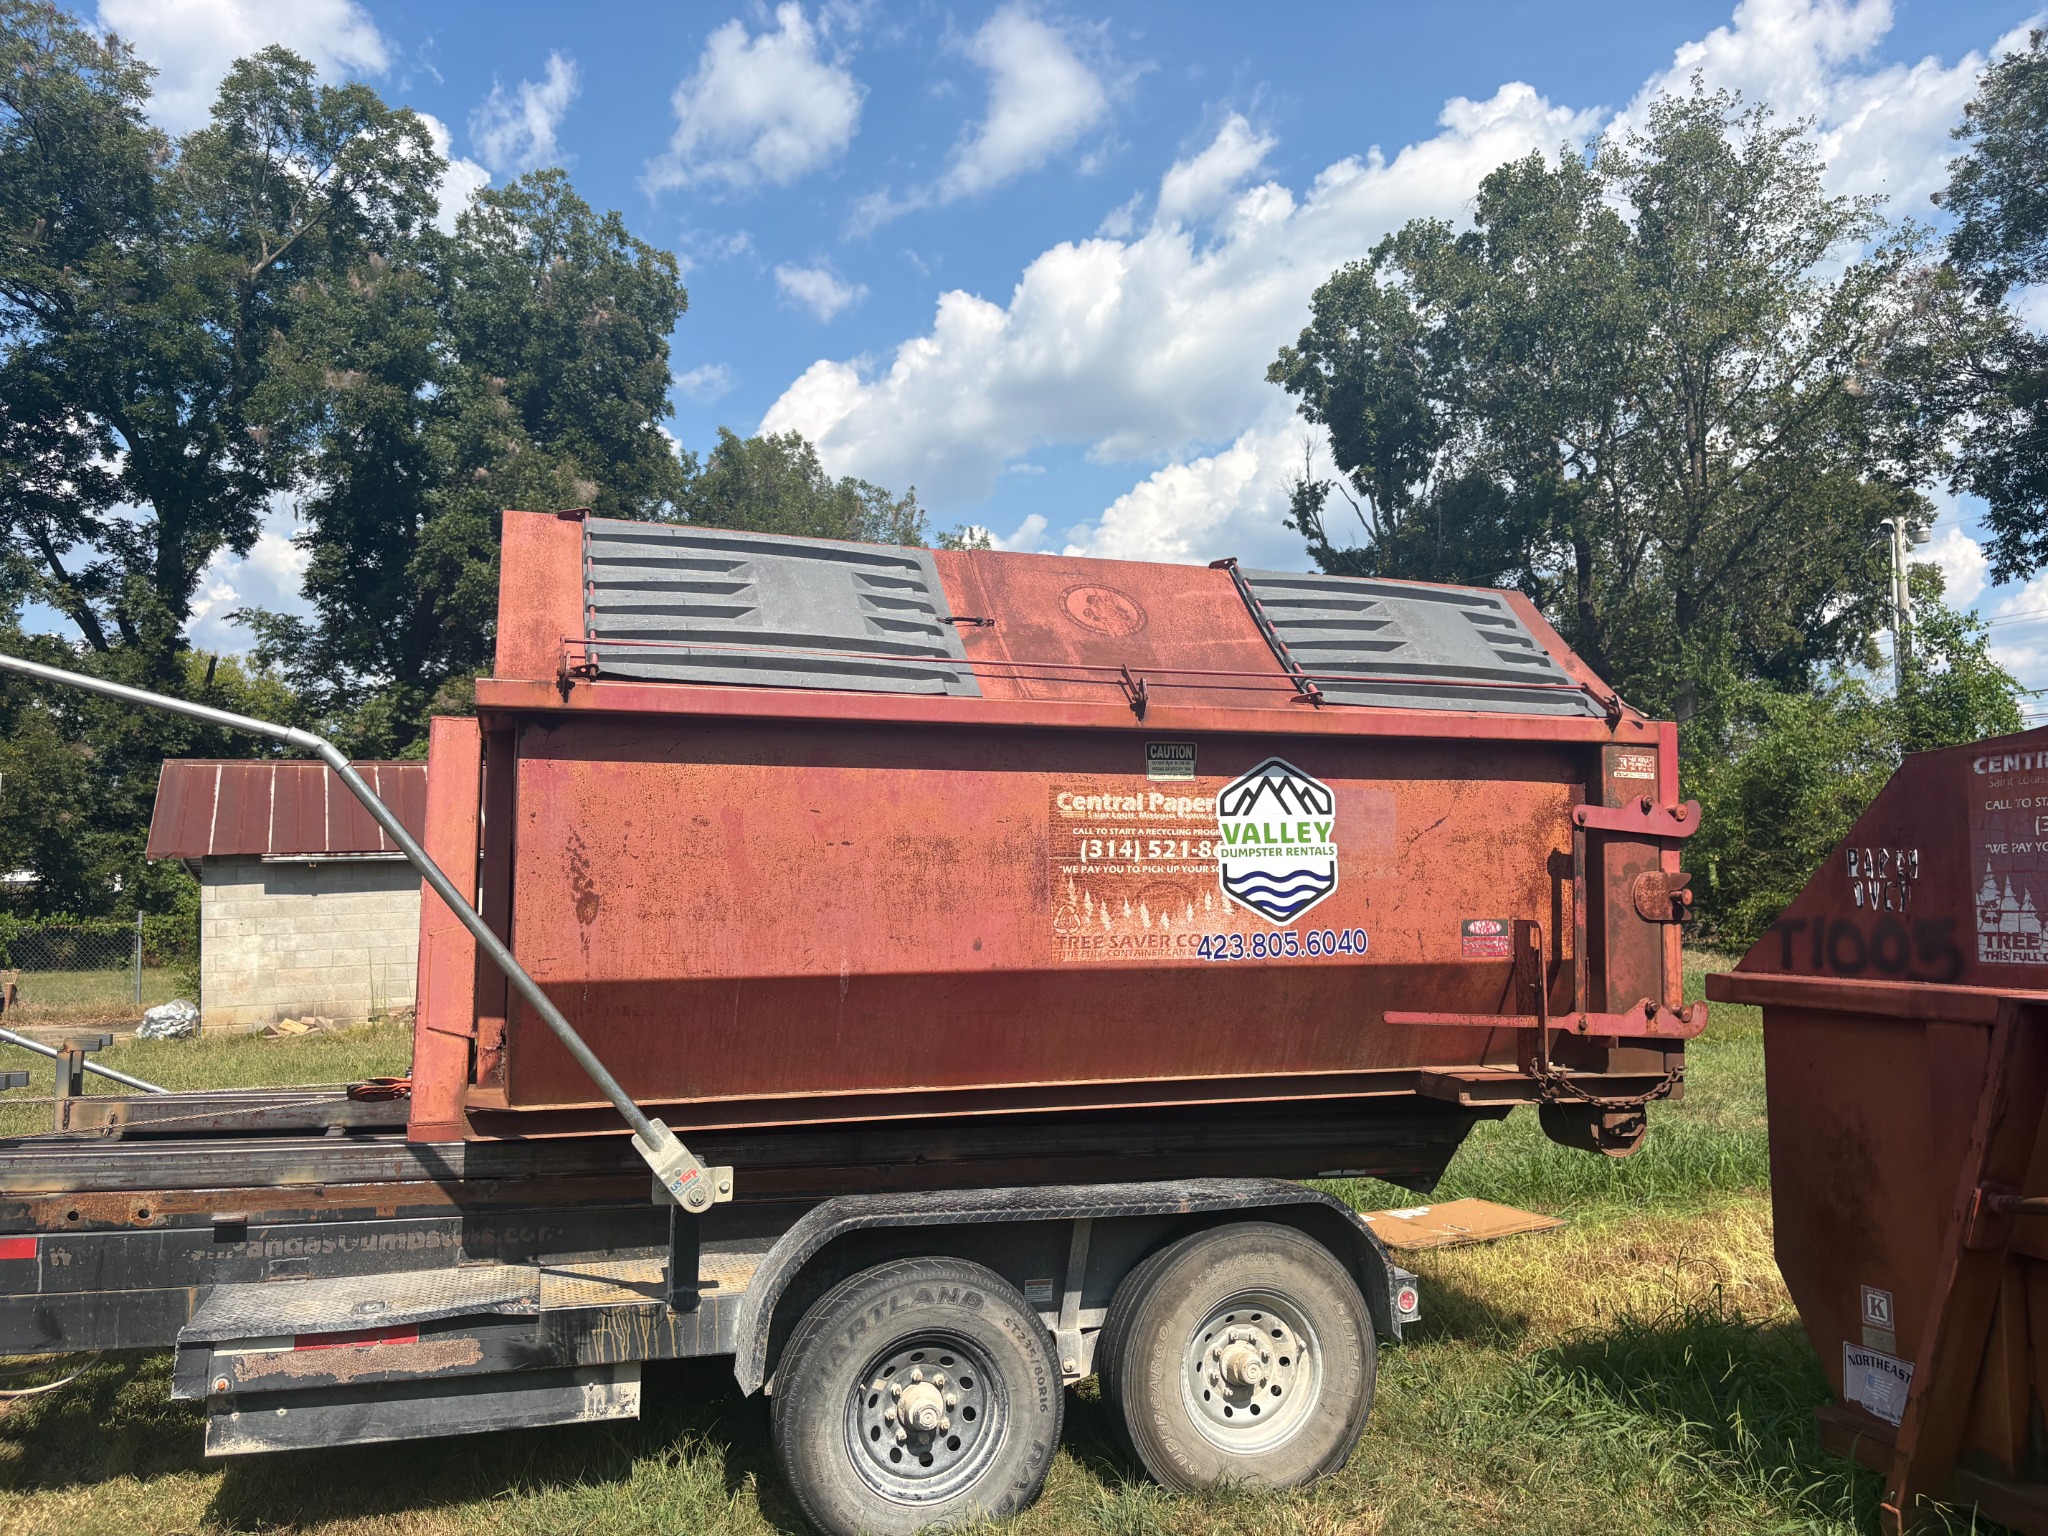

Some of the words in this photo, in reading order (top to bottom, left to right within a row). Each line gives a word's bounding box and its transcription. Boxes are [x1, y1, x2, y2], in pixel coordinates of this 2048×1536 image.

[1150, 744, 1193, 759] CAUTION
[1988, 776, 2014, 788] Saint
[1056, 791, 1144, 812] Central
[1149, 792, 1217, 818] Paper
[1985, 799, 2012, 811] CALL
[2015, 797, 2032, 808] TO
[1072, 827, 1094, 835] CALL
[1146, 828, 1191, 836] RECYCLING
[1221, 821, 1332, 845] VALLEY
[1080, 839, 1140, 863] (314)
[1220, 847, 1283, 858] DUMPSTER
[1285, 846, 1335, 857] RENTALS
[2011, 842, 2033, 854] PAY
[1080, 866, 1101, 874] PAY
[1102, 866, 1124, 874] YOU
[1126, 866, 1140, 874] TO
[1142, 866, 1165, 874] PICK
[1166, 866, 1180, 874] UP
[1182, 866, 1209, 874] YOUR
[1056, 935, 1104, 949] TREE
[1109, 934, 1171, 949] SAVER
[1197, 928, 1367, 961] 423.805.6040
[1983, 931, 2041, 950] TREE
[1106, 948, 1165, 958] CONTAINER
[1166, 948, 1186, 957] CAN
[1984, 950, 2009, 960] THIS
[2013, 952, 2038, 961] FULL
[1869, 1295, 1886, 1320] K
[815, 1286, 985, 1398] HARTLAND
[1002, 1316, 1049, 1414] ST235/80R16
[1847, 1354, 1912, 1385] NORTHEAST
[1149, 1324, 1199, 1477] SUPERCARGO
